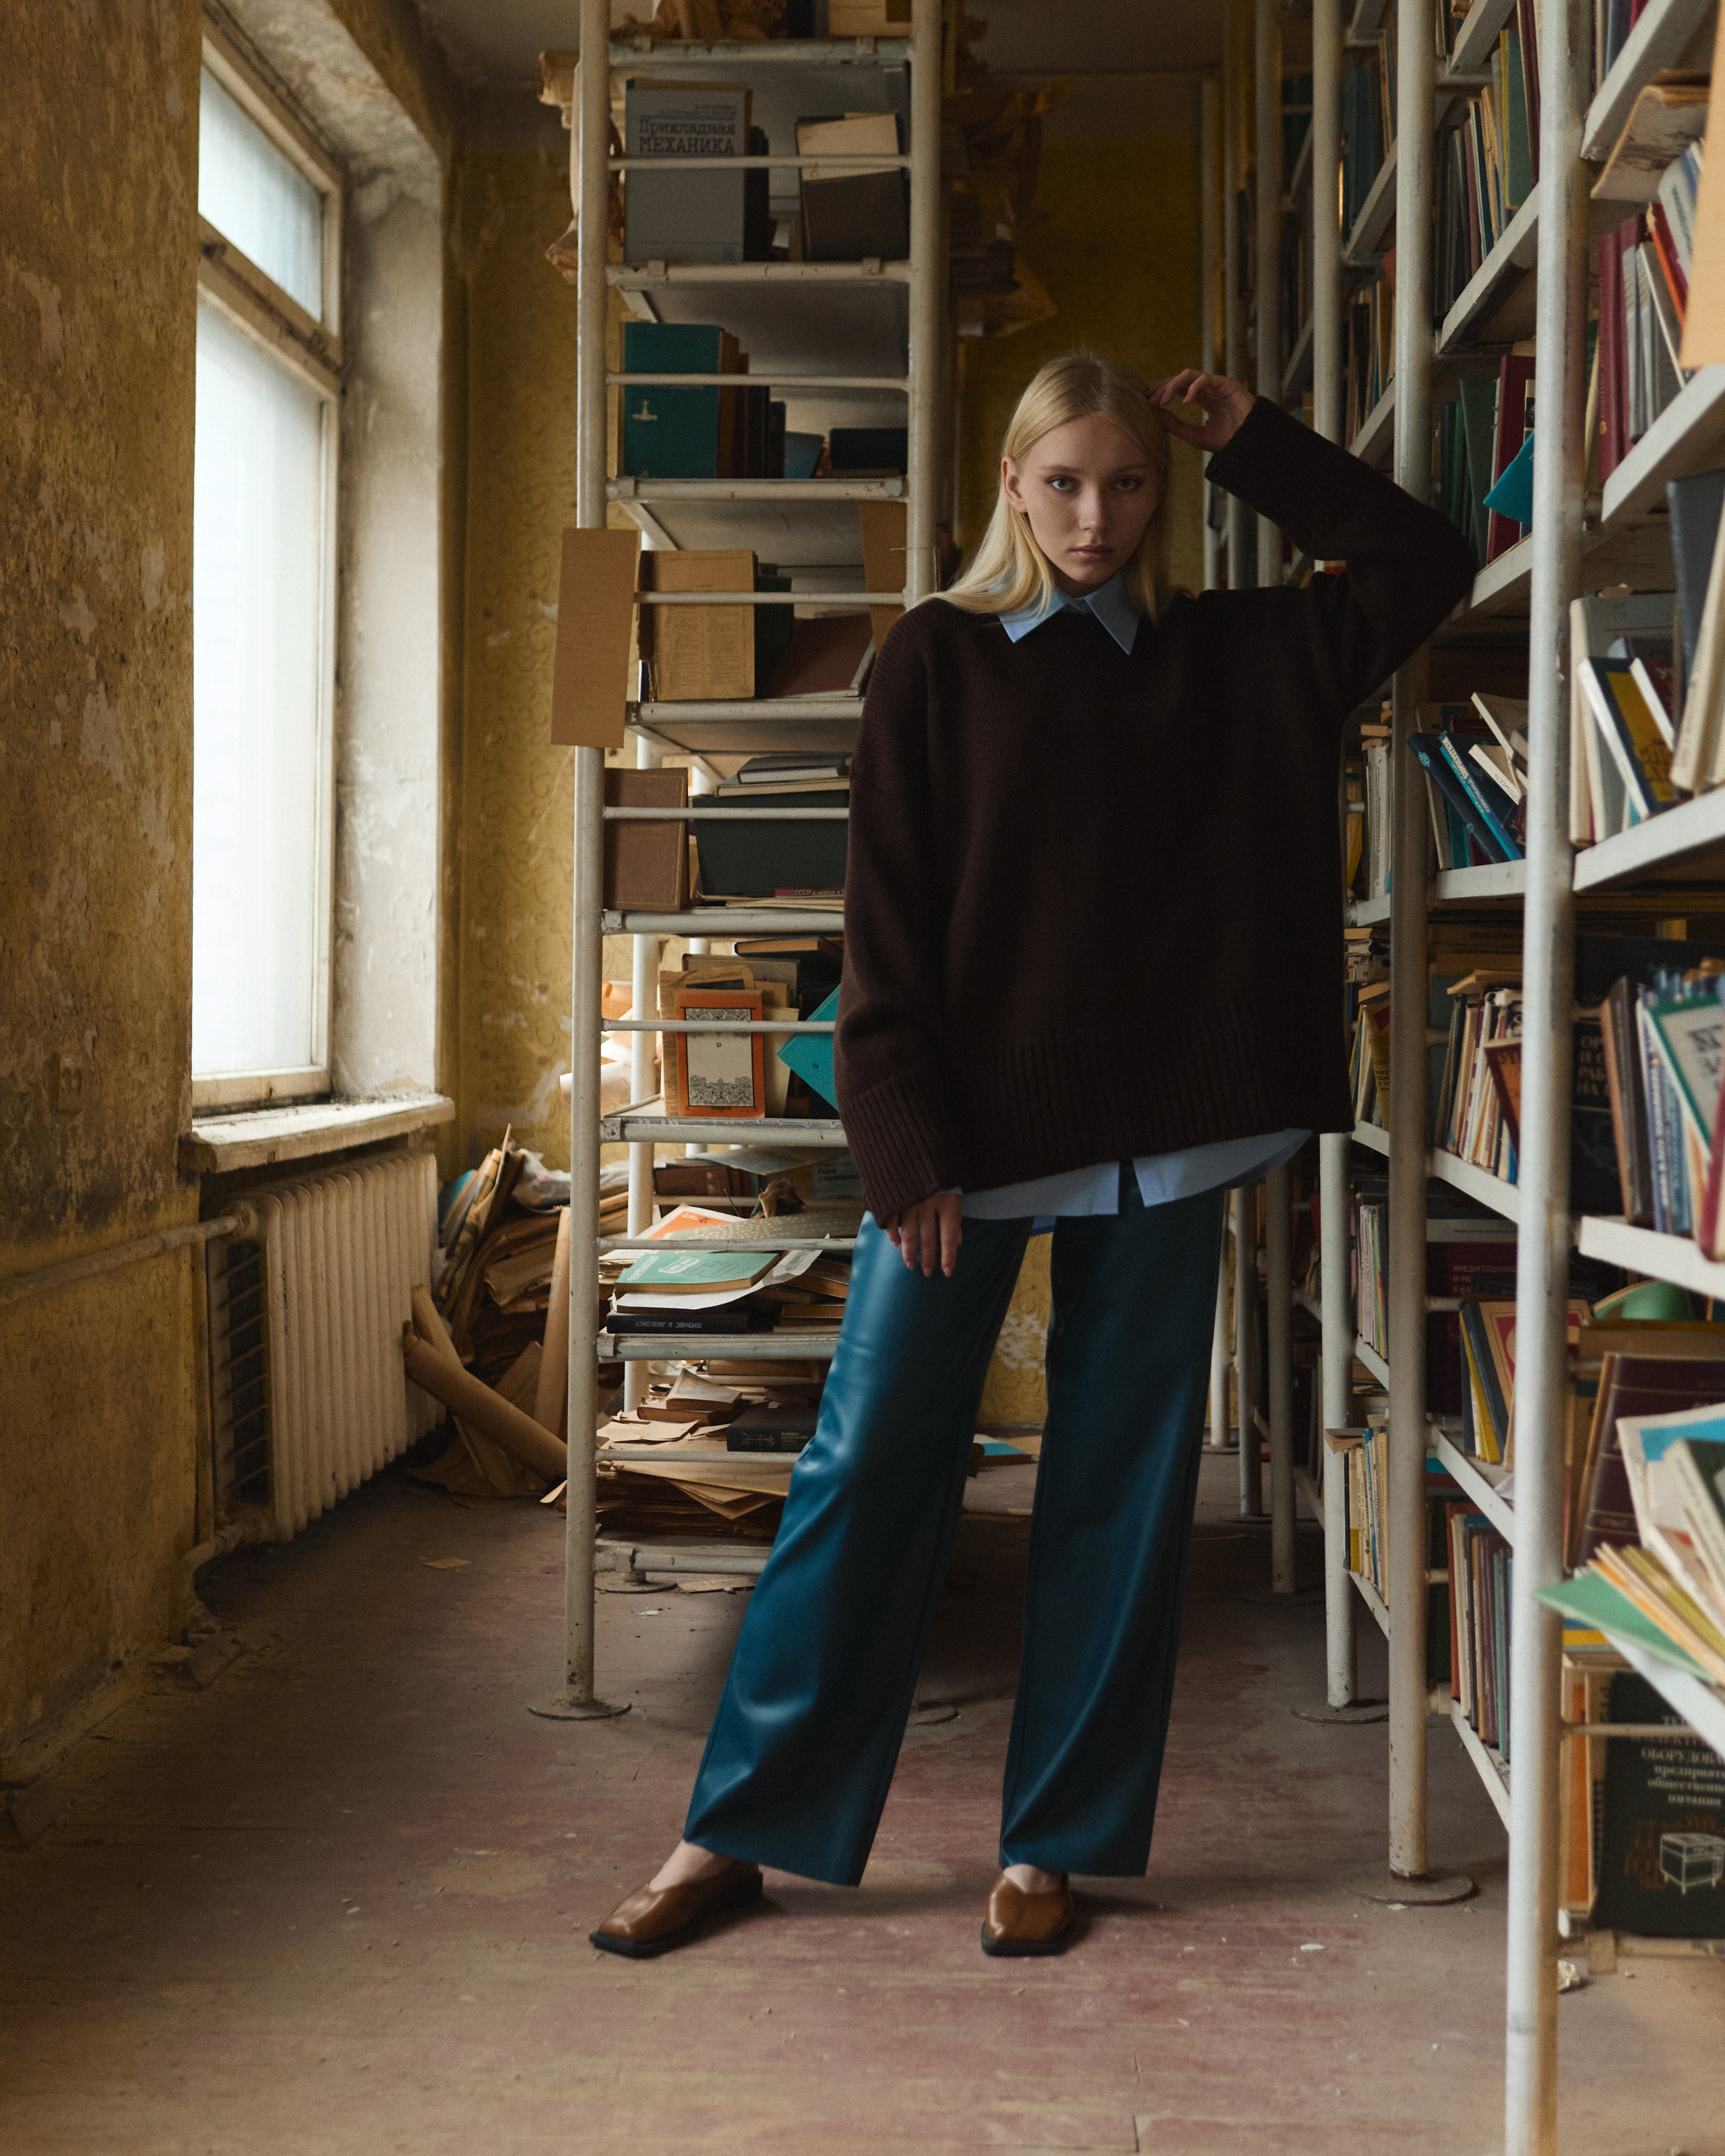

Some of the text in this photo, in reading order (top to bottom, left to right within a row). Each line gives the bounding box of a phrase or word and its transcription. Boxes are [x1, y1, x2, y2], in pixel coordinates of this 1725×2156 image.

[639, 119, 736, 136] Прикладная
[639, 136, 735, 154] МЕХАНИКА
[1453, 1265, 1517, 1273] КРЕДИТОВАНИЕ
[1667, 1793, 1722, 1807] питания
